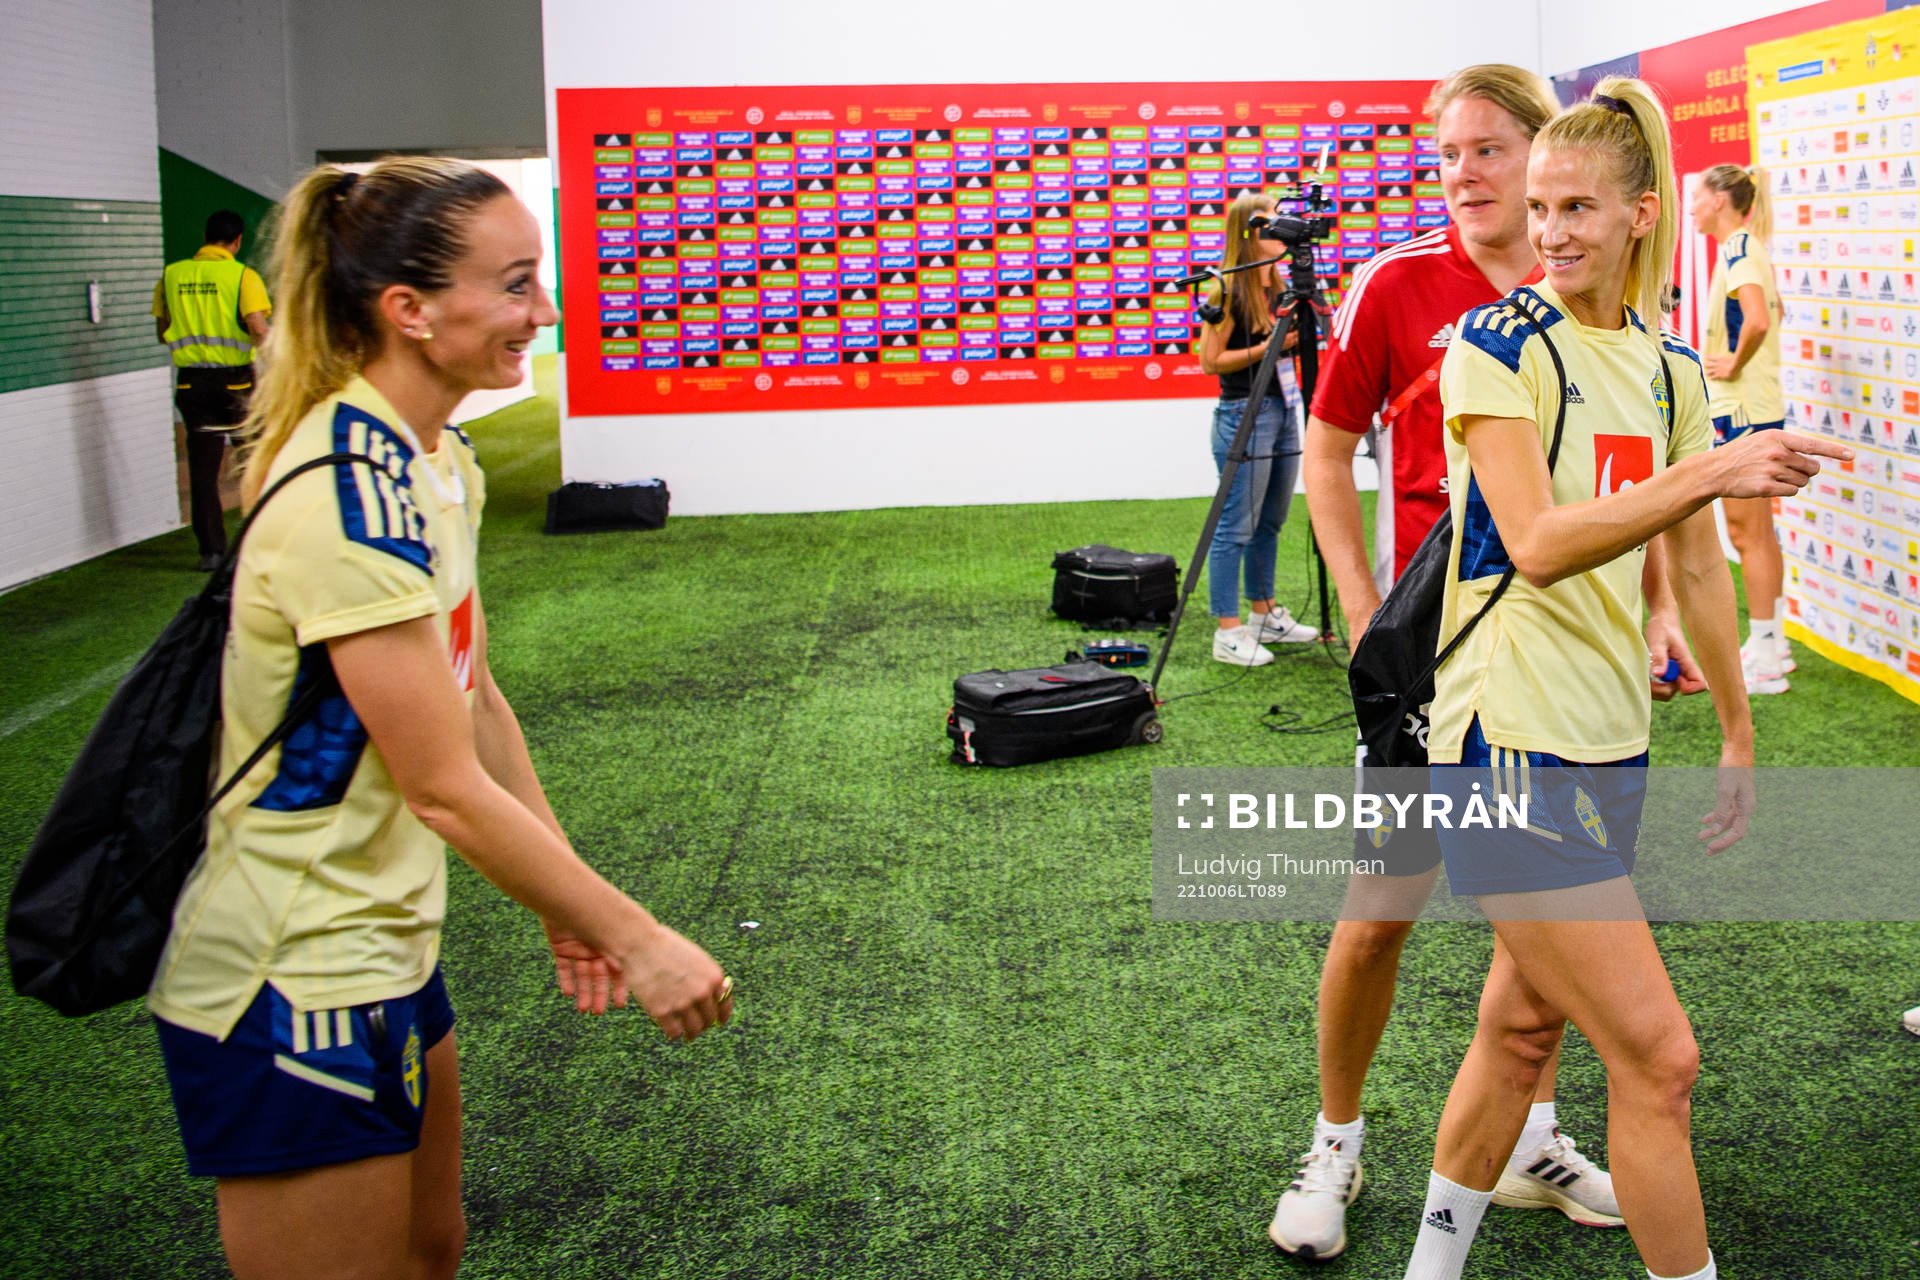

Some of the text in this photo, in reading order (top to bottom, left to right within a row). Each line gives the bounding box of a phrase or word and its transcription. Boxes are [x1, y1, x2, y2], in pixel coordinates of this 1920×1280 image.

[1673, 94, 1740, 122] ESPAÑOLA
[1566, 395, 1585, 404] didas
[1425, 1216, 1458, 1234] adidas
